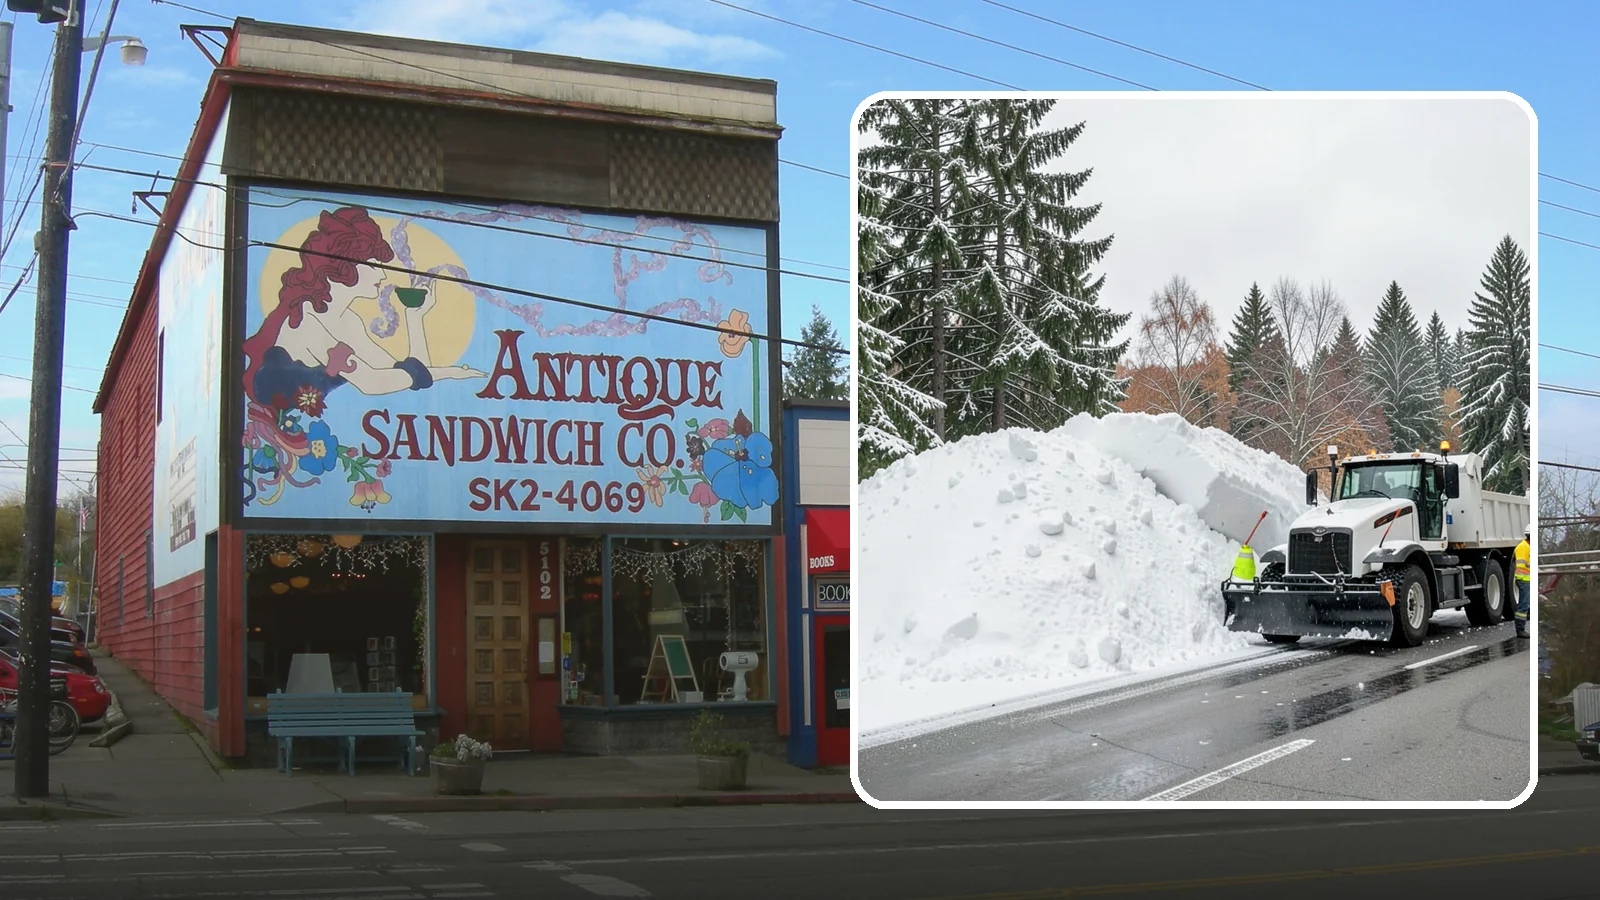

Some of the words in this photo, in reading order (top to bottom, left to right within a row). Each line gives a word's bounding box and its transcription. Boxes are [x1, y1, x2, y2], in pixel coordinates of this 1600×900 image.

[475, 329, 723, 421] ANTIQUE
[361, 408, 605, 468] SANDWICH
[617, 421, 685, 469] CO.
[468, 477, 646, 514] SK2-4069
[539, 541, 552, 601] 5102
[809, 555, 835, 569] BOOKS
